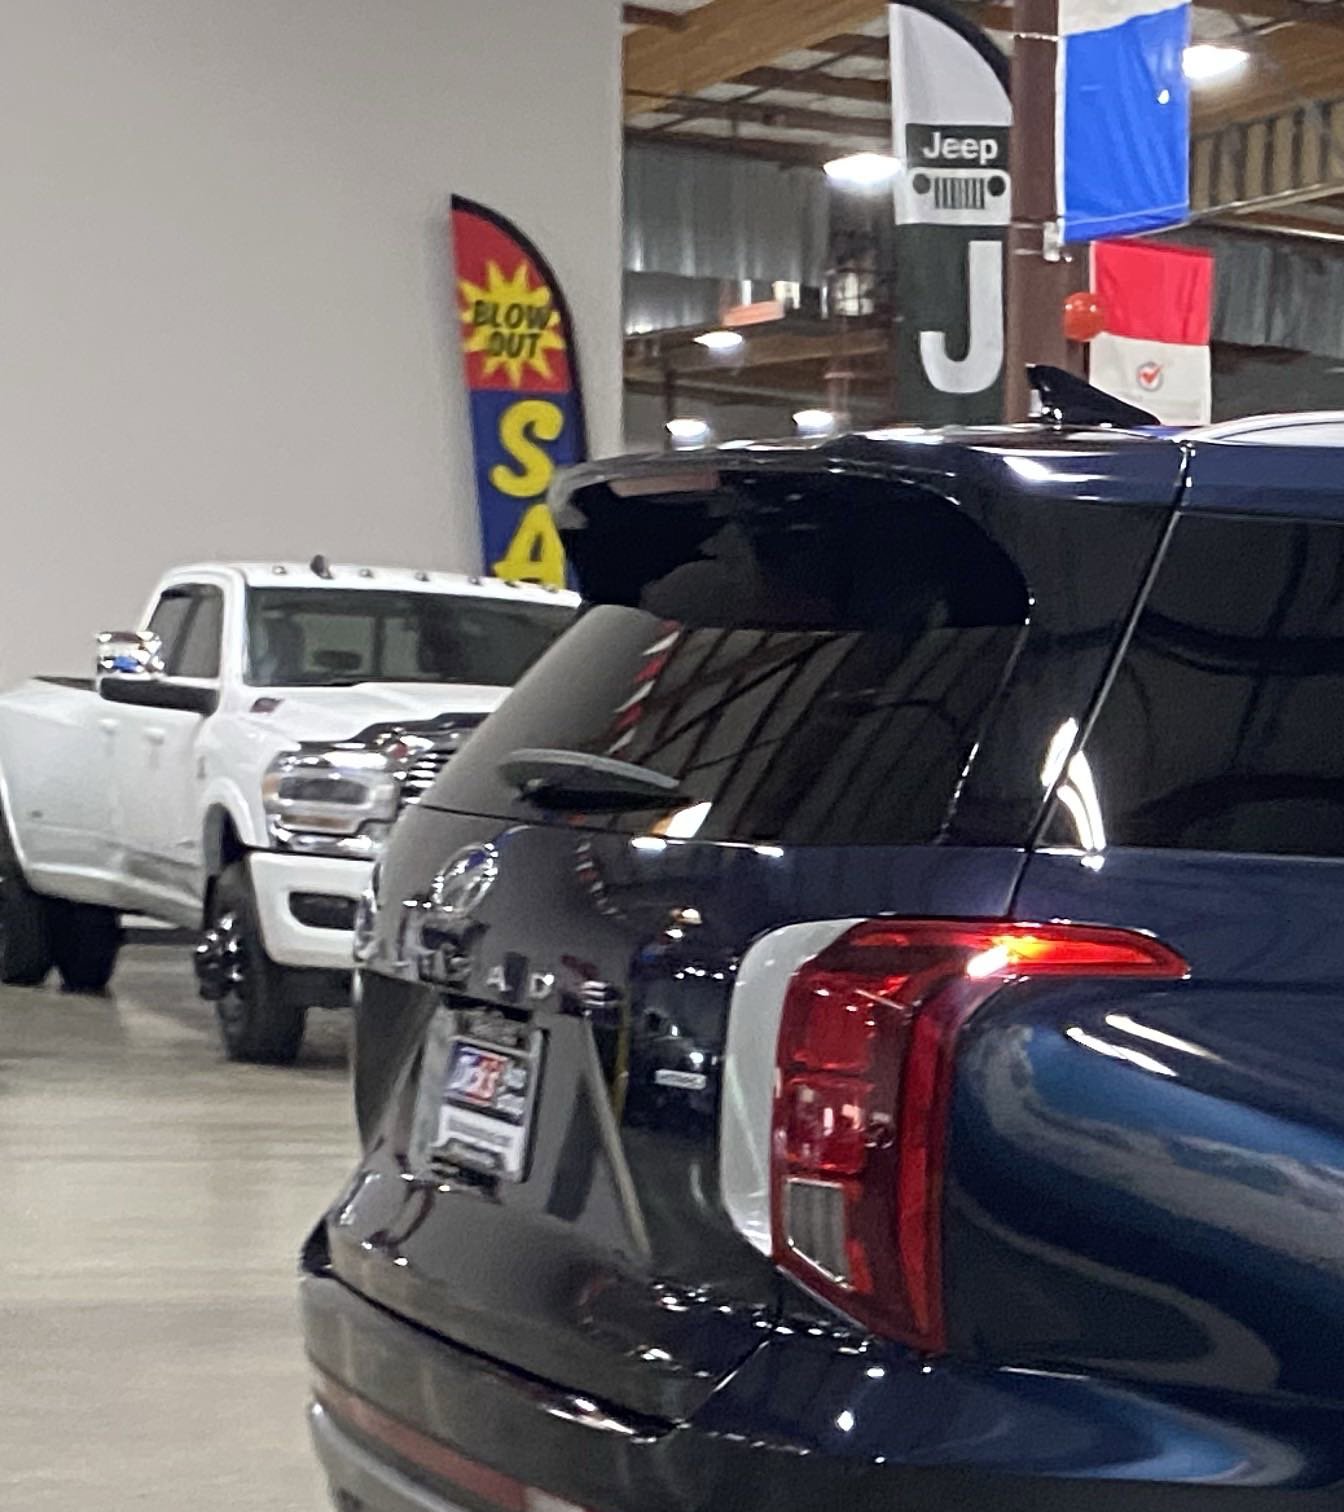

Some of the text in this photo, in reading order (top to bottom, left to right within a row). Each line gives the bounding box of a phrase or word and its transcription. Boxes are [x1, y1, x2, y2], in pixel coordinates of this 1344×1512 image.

[922, 131, 998, 165] Jeep
[472, 300, 550, 331] BLOW
[487, 332, 541, 359] OUT
